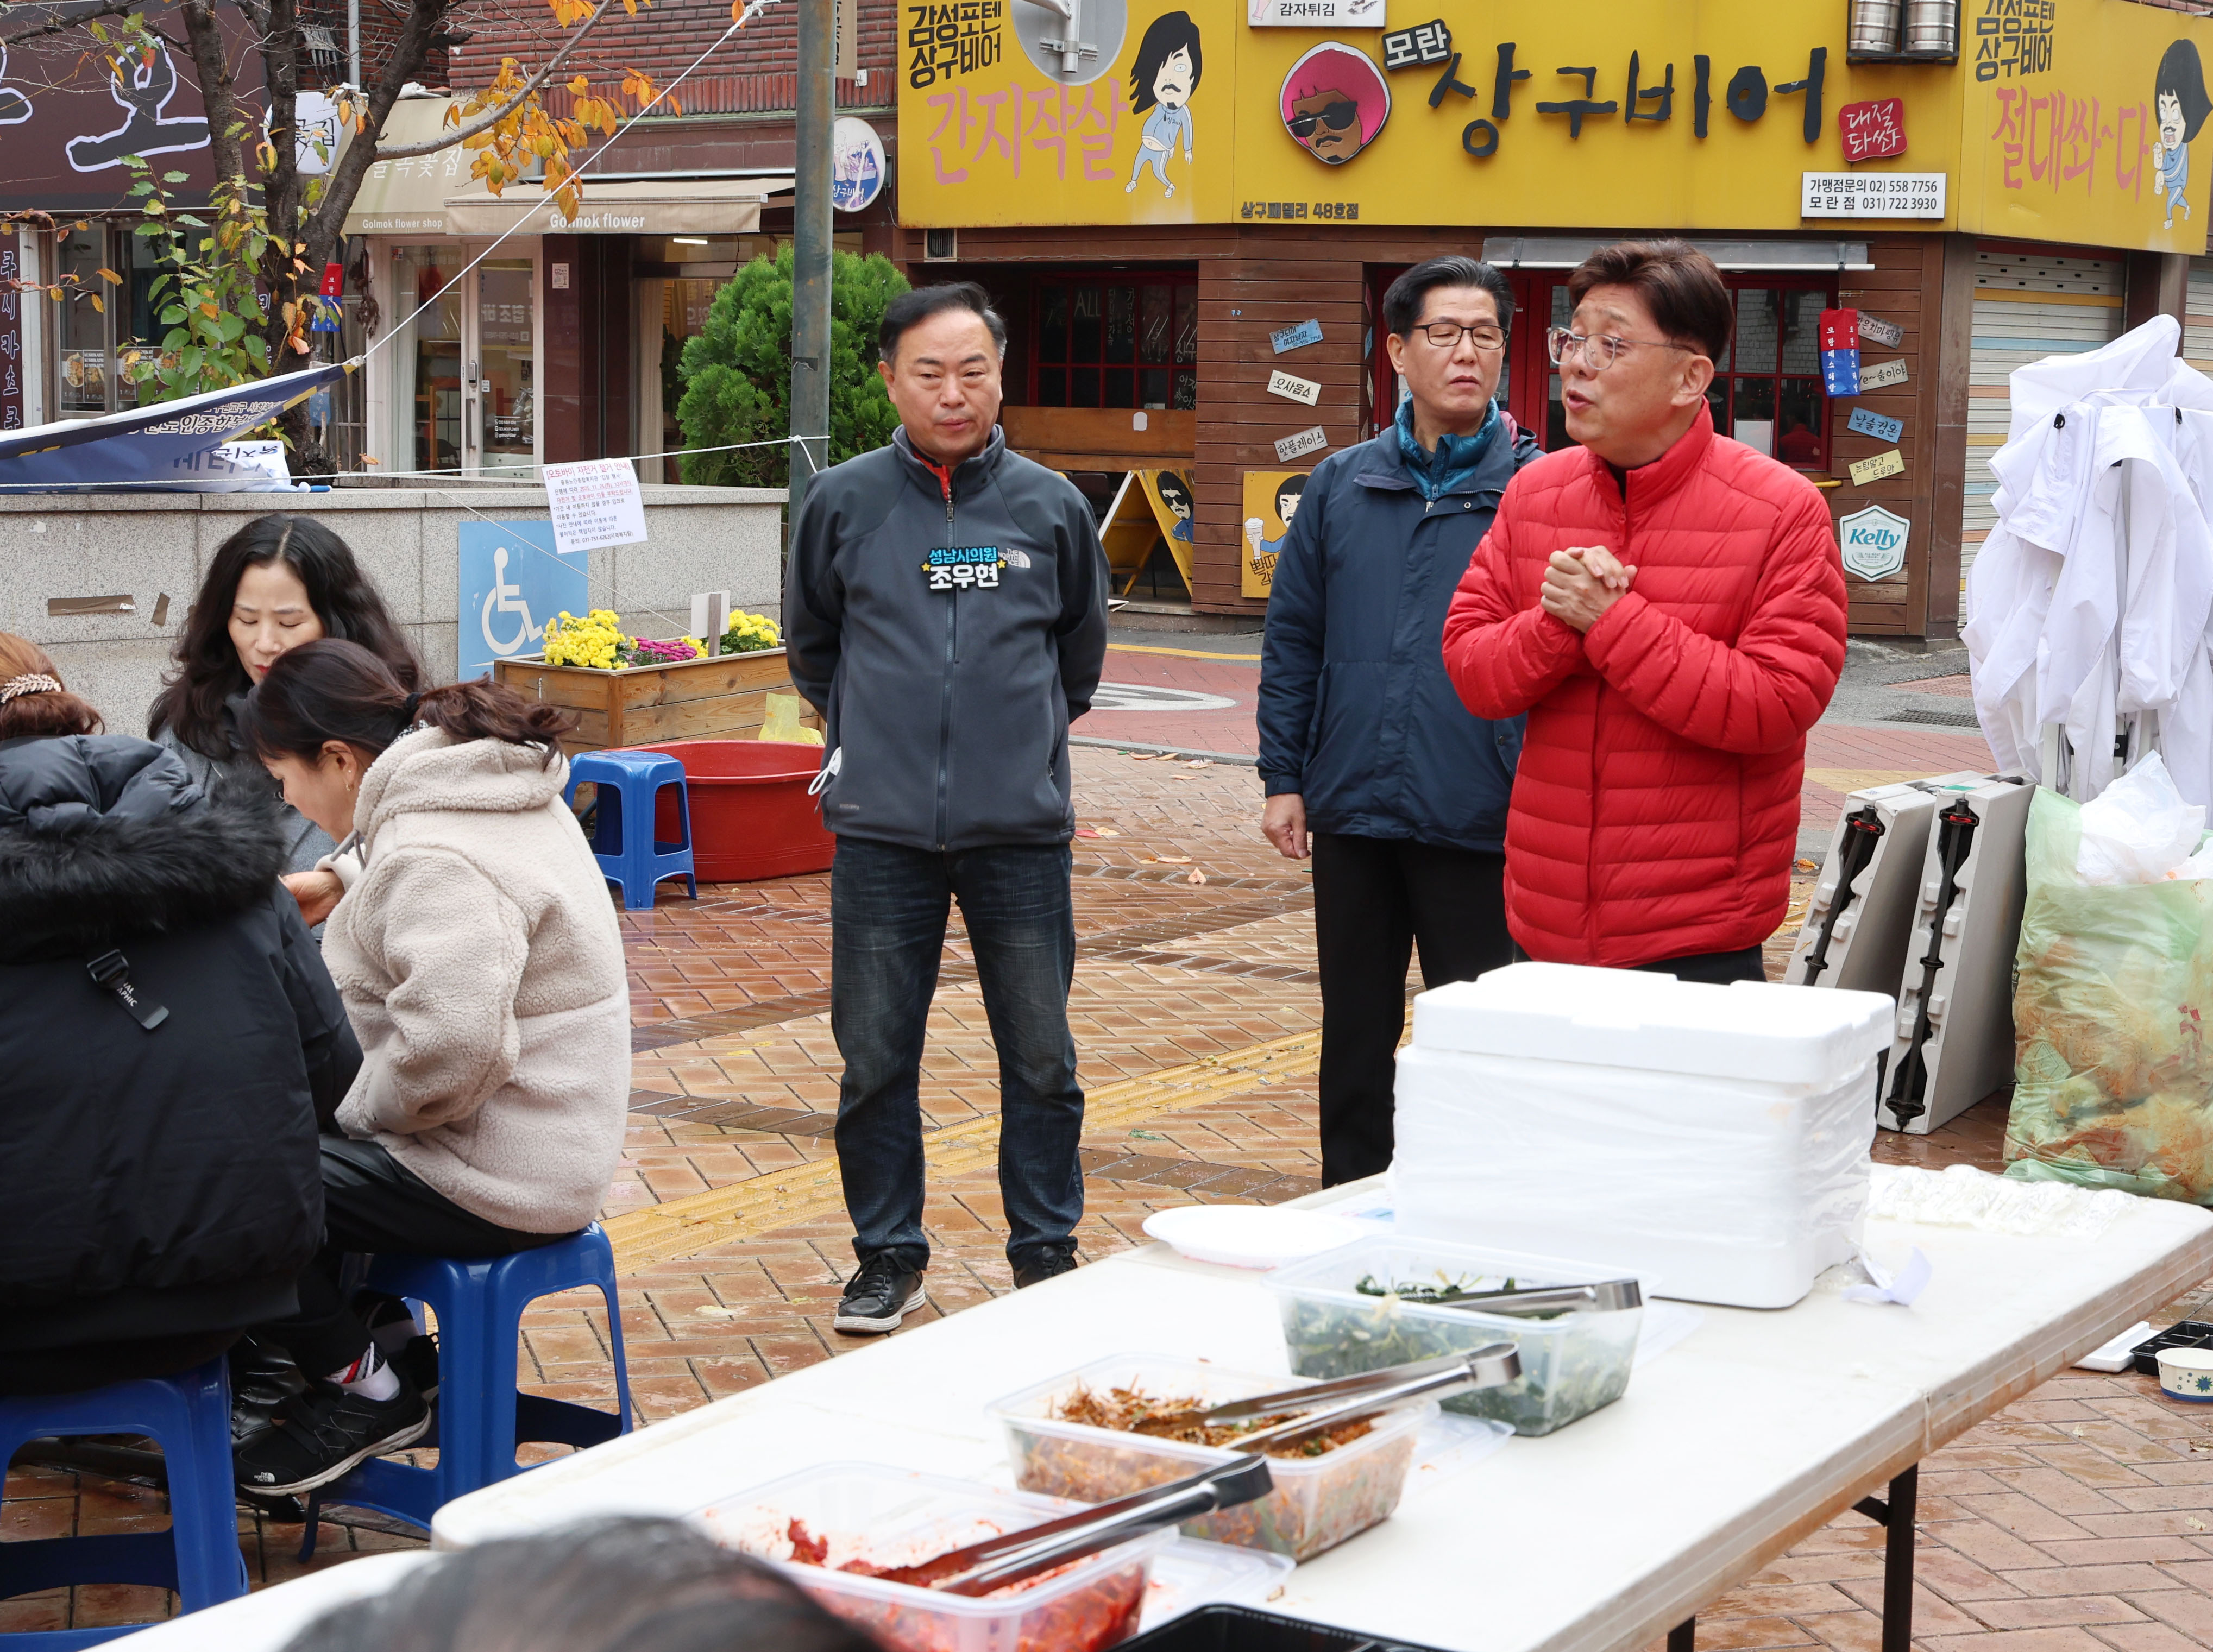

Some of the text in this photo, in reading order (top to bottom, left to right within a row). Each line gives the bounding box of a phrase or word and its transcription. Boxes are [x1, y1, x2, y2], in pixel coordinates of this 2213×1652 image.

[1280, 3, 1335, 16] 감자튀김
[1976, 0, 2055, 35] 감성포텐
[908, 1, 1001, 48] 감성포텐
[1385, 22, 1449, 67] 모란
[909, 32, 1001, 89] 상구비어
[1975, 35, 2053, 82] 상구비어
[1428, 42, 1827, 157] 상구비어
[926, 77, 1129, 186] 간지작살
[1810, 179, 1937, 193] 가맹점문의 02) 558 7756
[1241, 201, 1359, 219] 상구패밀리 48호점
[1863, 197, 1885, 211] 031)
[1889, 198, 1908, 209] 722
[1910, 198, 1937, 209] 3930
[362, 218, 443, 229] Golmok flower shop
[550, 213, 645, 228] Gomok flower
[1074, 291, 1101, 317] ALL
[1277, 431, 1325, 458] 핫플레이스
[577, 465, 597, 475] 자전거
[599, 464, 613, 472] 철거
[1849, 528, 1901, 550] Kelly
[929, 547, 997, 565] 성남시의원
[929, 563, 999, 589] 조우현
